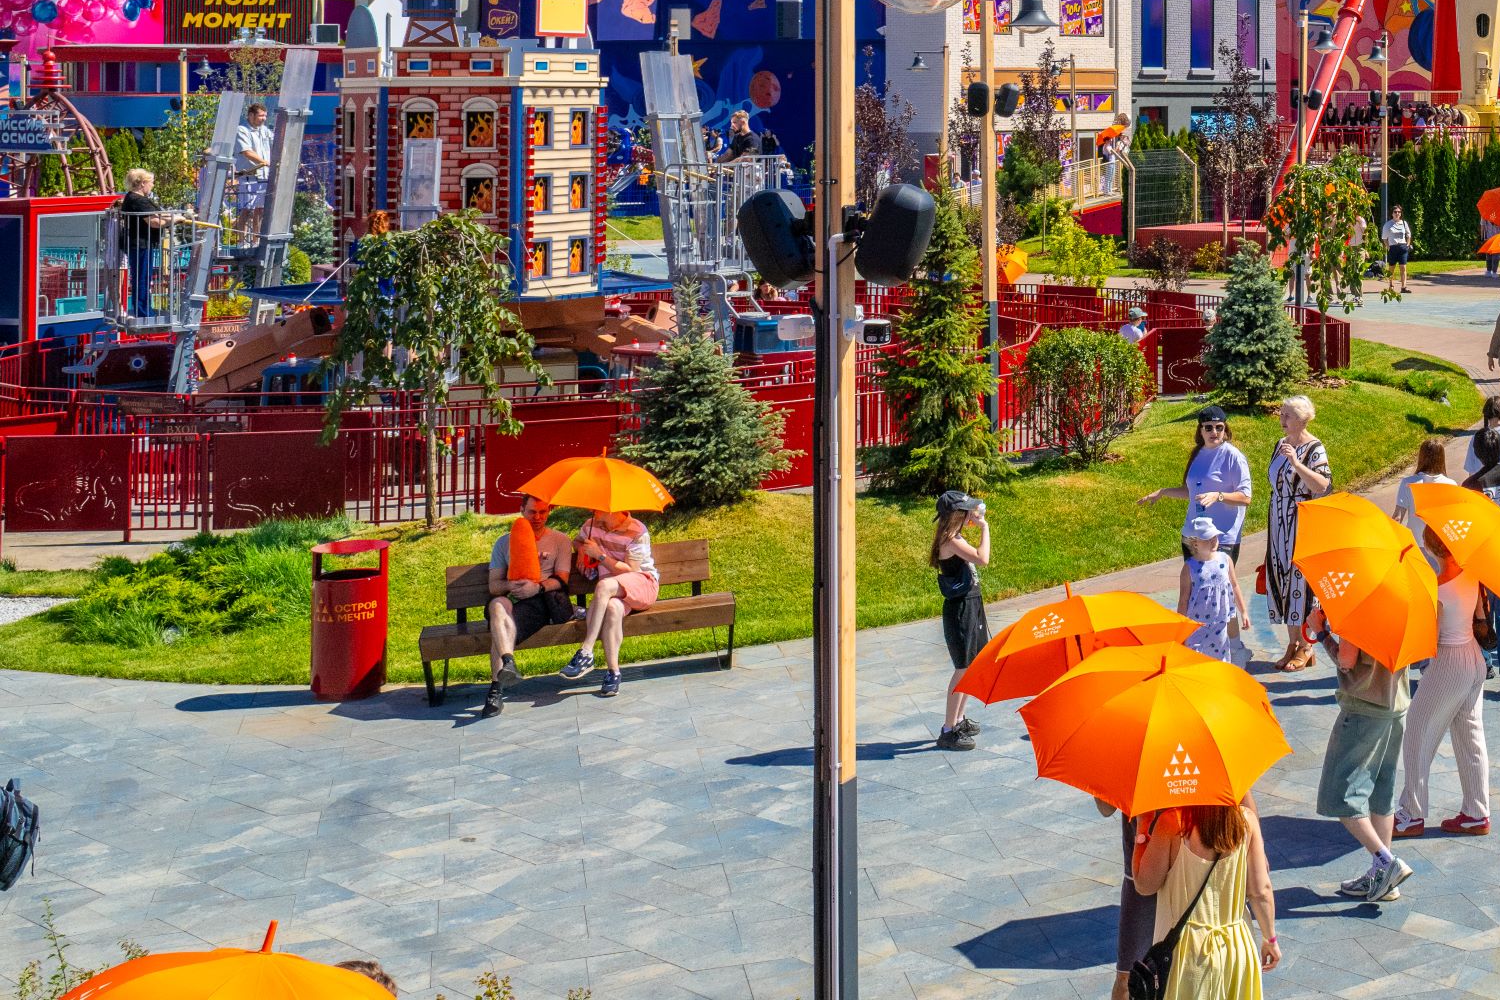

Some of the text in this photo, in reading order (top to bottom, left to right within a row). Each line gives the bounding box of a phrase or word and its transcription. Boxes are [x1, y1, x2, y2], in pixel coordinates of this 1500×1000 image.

[182, 12, 292, 28] МОМЕНТ
[0, 132, 46, 144] ОСМОС
[211, 325, 240, 334] ВЫХОД
[166, 424, 198, 434] ВХОД
[334, 600, 378, 613] ОСТРОВ
[337, 610, 375, 622] МЕЧТЫ
[1167, 779, 1198, 788] ОСТРОВ
[1169, 787, 1197, 795] МЕЧТЫ
